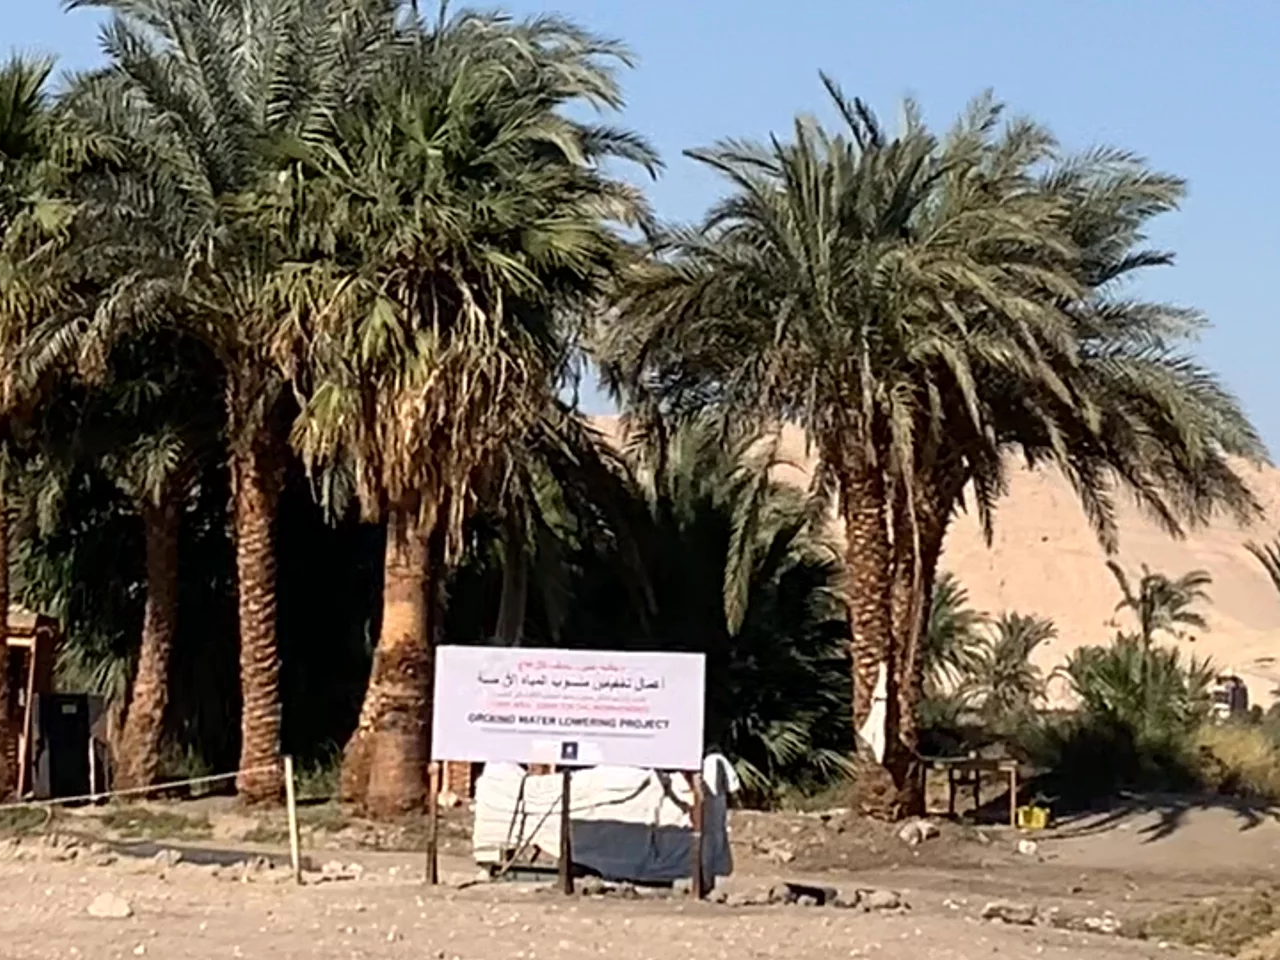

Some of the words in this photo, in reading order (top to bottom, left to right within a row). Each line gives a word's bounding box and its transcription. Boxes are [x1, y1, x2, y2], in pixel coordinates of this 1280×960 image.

[518, 715, 556, 726] WATER
[558, 716, 616, 728] LOWERING
[619, 718, 670, 730] PROJECT
